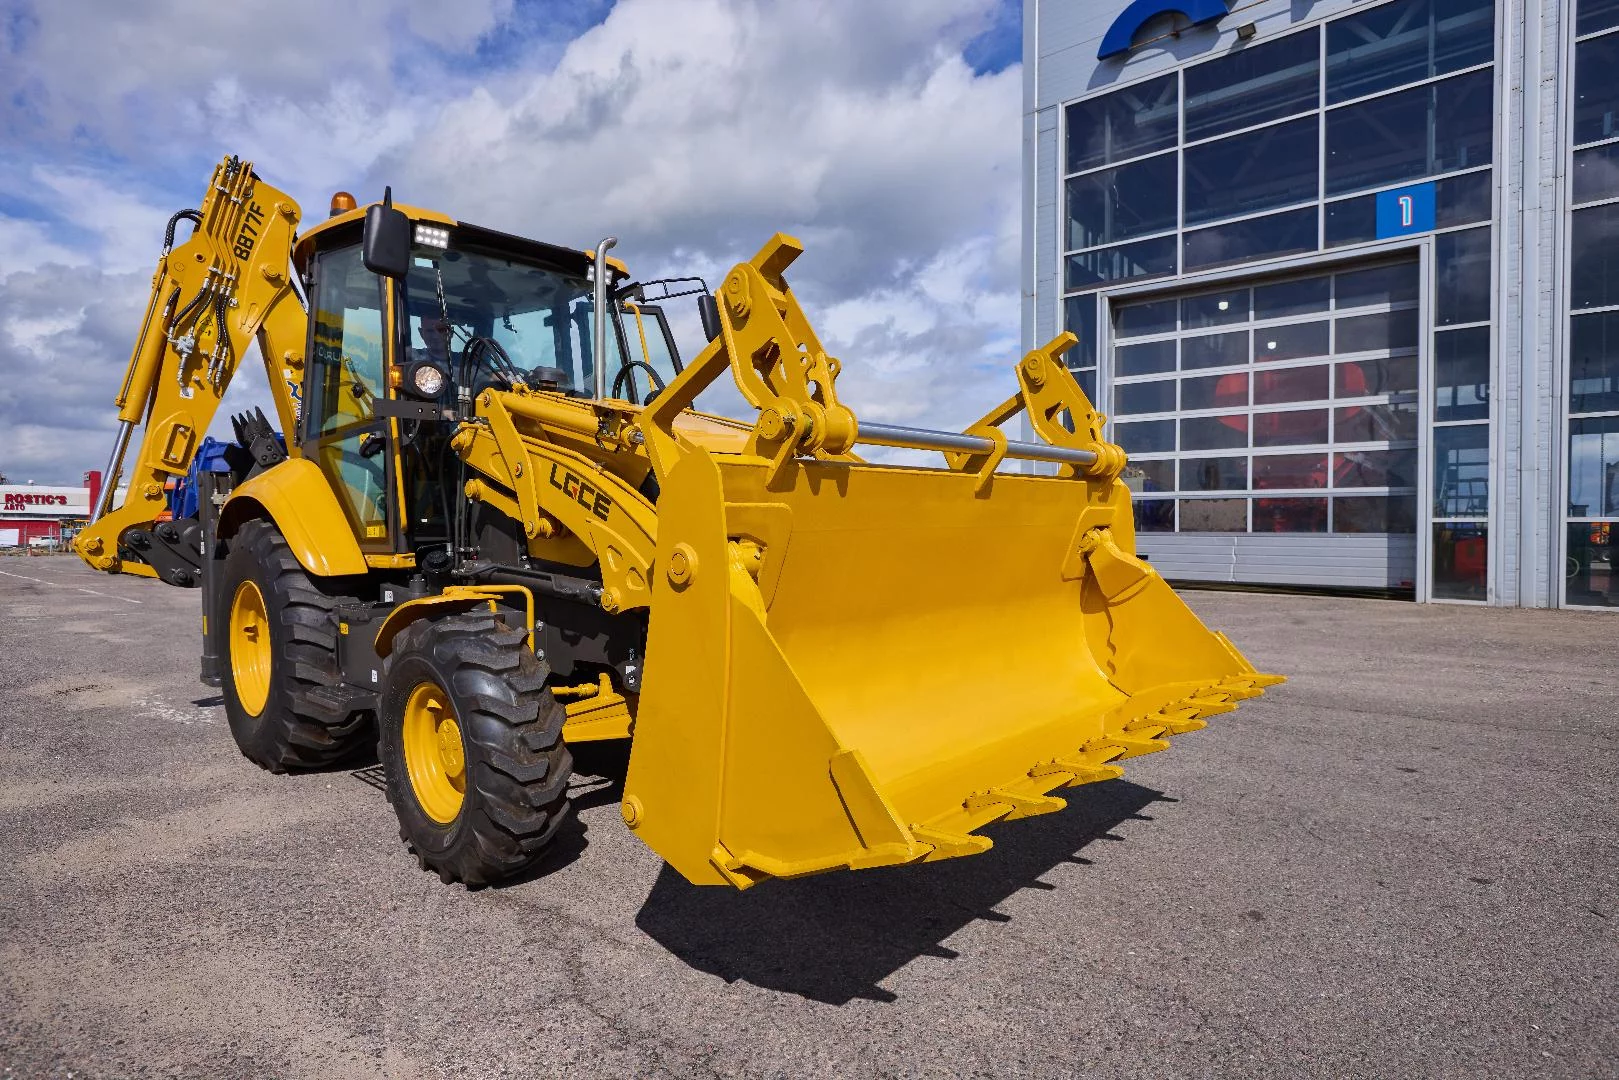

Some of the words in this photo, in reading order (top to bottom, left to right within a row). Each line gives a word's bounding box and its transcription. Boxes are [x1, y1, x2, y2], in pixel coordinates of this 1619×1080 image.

[233, 201, 265, 261] 8877F
[1399, 196, 1412, 226] 1
[4, 493, 67, 505] ROSTIC'S
[549, 462, 612, 522] LGCE
